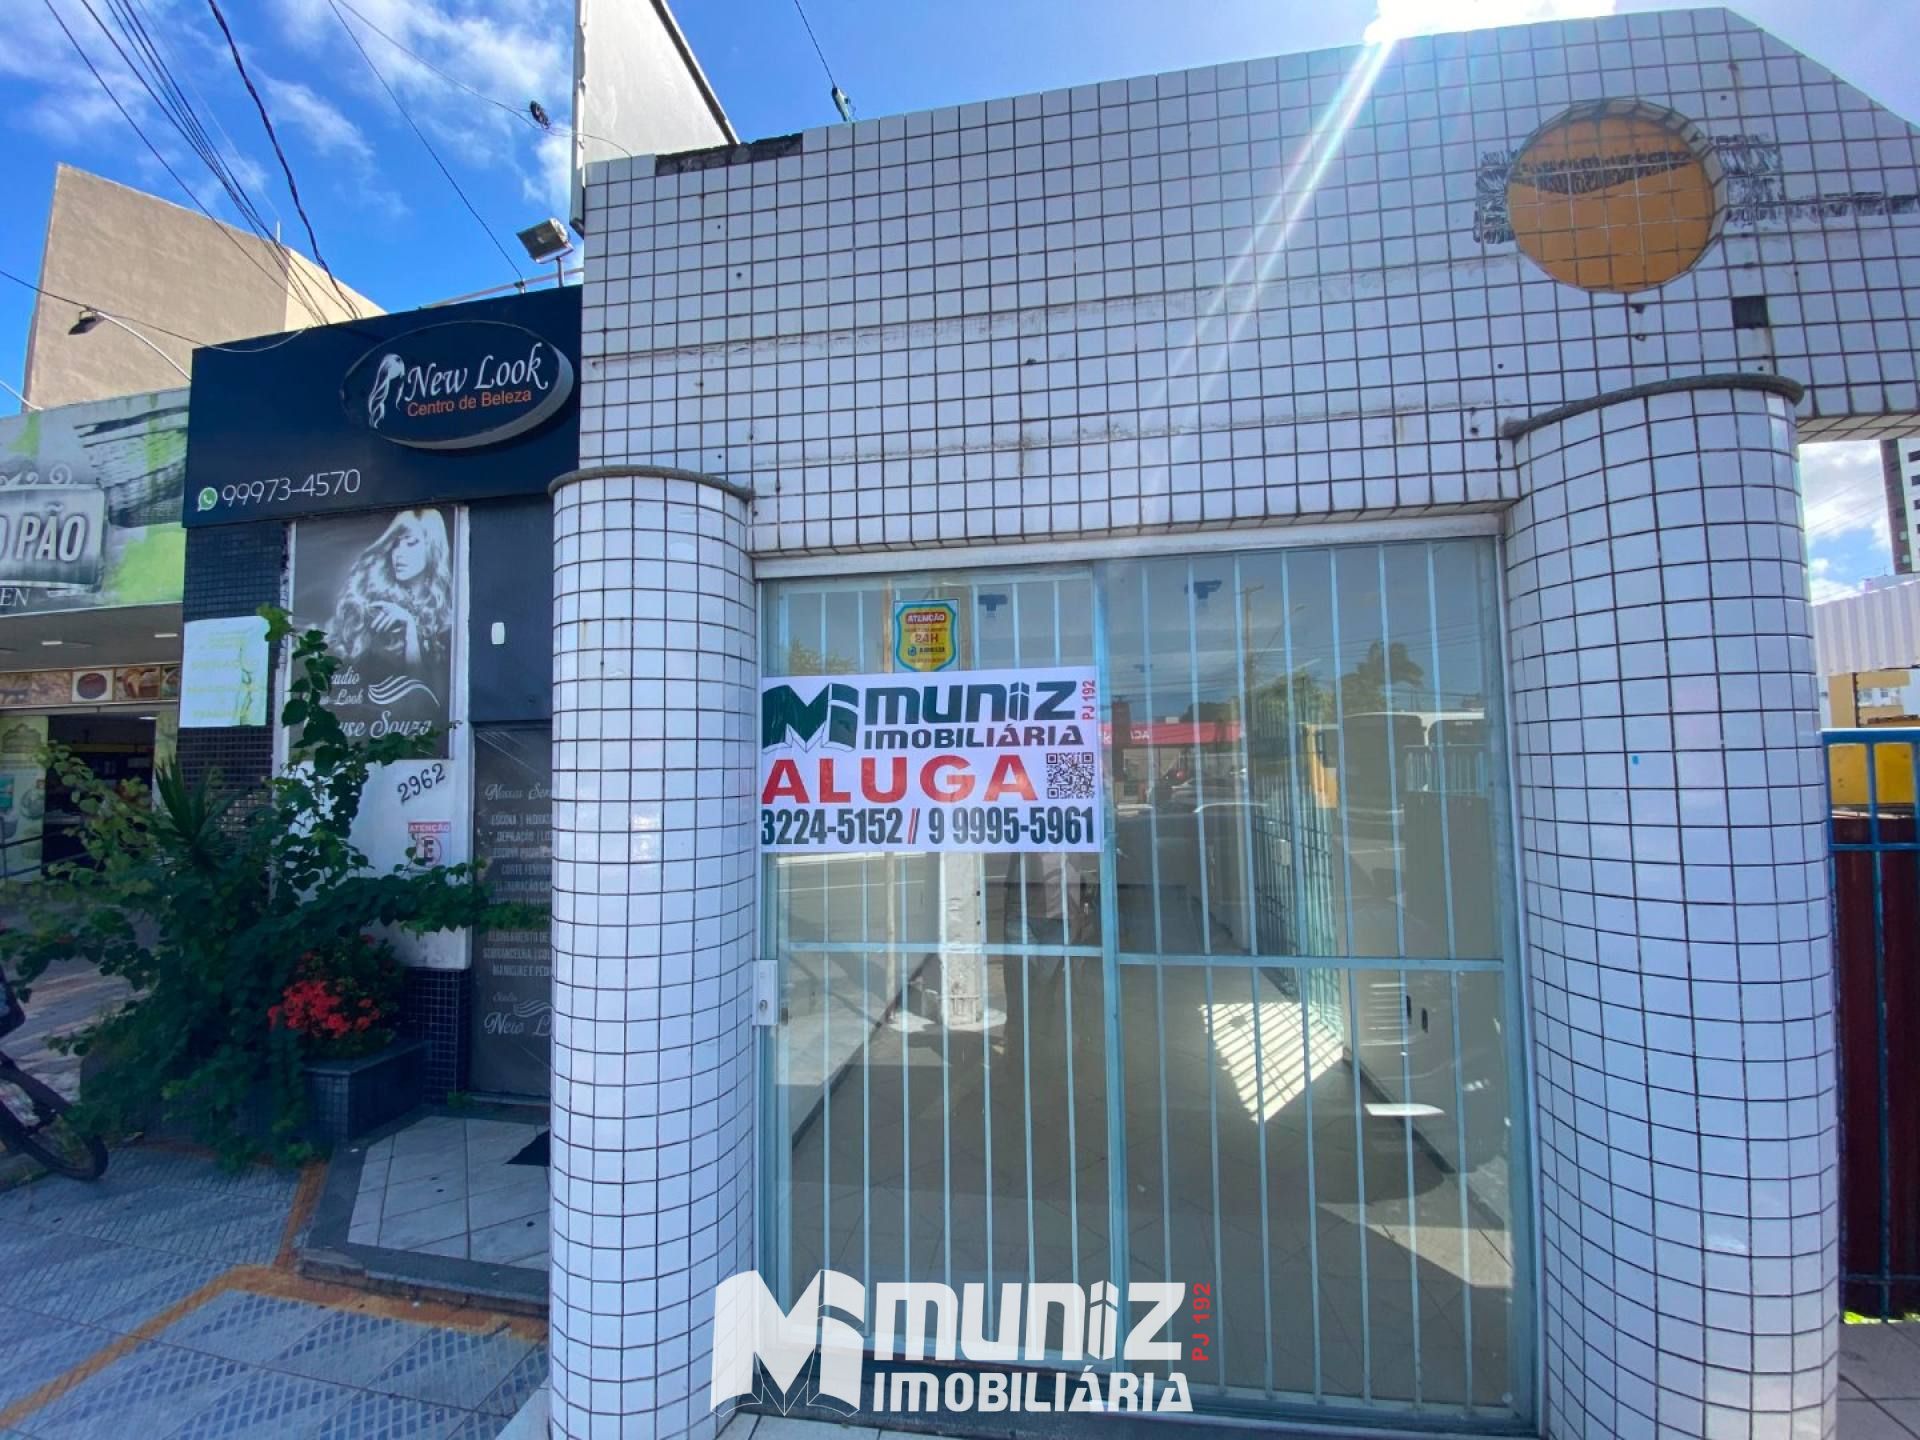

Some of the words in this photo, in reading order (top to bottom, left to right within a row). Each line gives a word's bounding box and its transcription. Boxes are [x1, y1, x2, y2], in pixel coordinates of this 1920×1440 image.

[405, 362, 468, 402] New
[473, 342, 549, 390] Look
[407, 400, 454, 417] Centro
[458, 395, 477, 410] de
[481, 389, 532, 407] Beleza
[222, 468, 361, 507] 99973-4570
[16, 502, 87, 562] PÃO
[1082, 680, 1096, 701] 192
[398, 763, 446, 804] 2962
[761, 754, 1039, 805] ALUGA
[410, 822, 450, 834] ATENÇÃO
[761, 807, 903, 845] 3224-5152
[928, 808, 945, 845] 9
[952, 806, 1095, 845] 9995-5961
[483, 1011, 524, 1035] New
